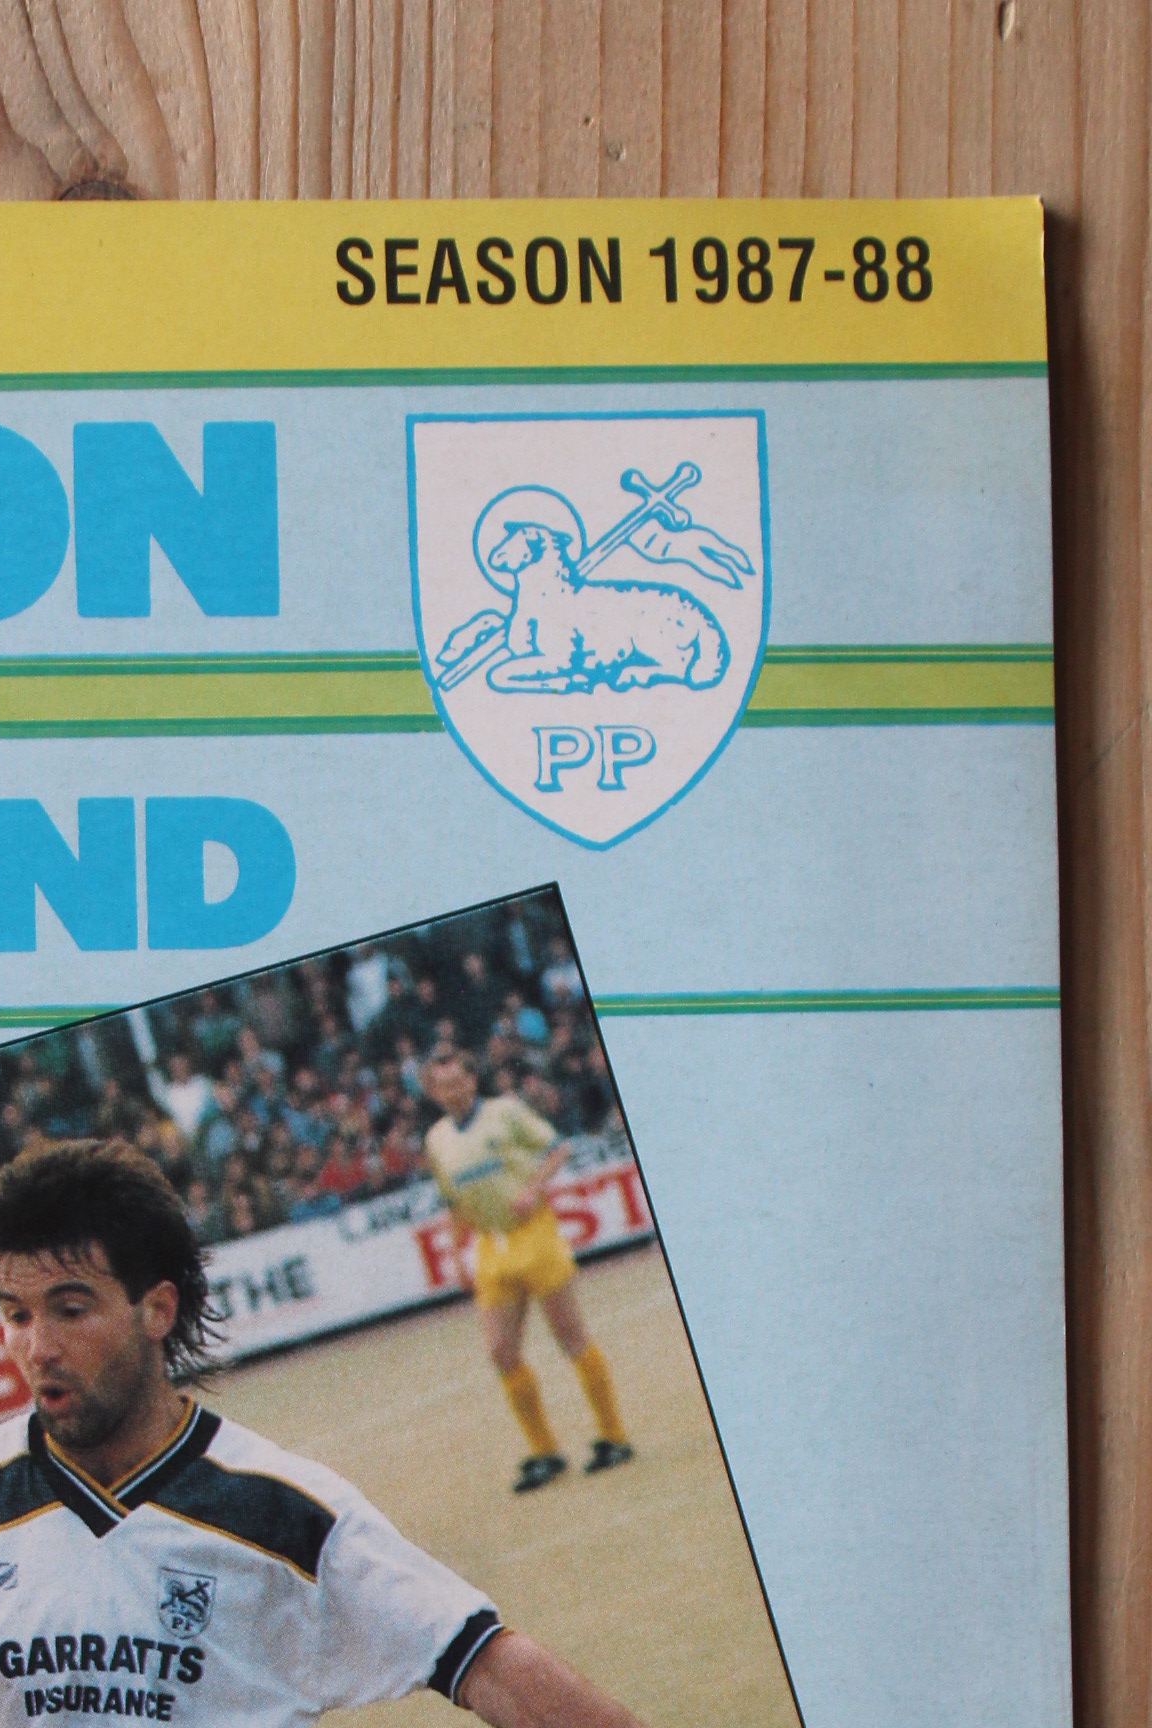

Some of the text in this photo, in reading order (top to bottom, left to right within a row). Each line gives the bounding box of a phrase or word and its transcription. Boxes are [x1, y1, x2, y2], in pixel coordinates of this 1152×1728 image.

[336, 236, 933, 306] SEASON 1987-88
[532, 726, 656, 793] PP
[23, 1685, 177, 1722] INSURANCE
